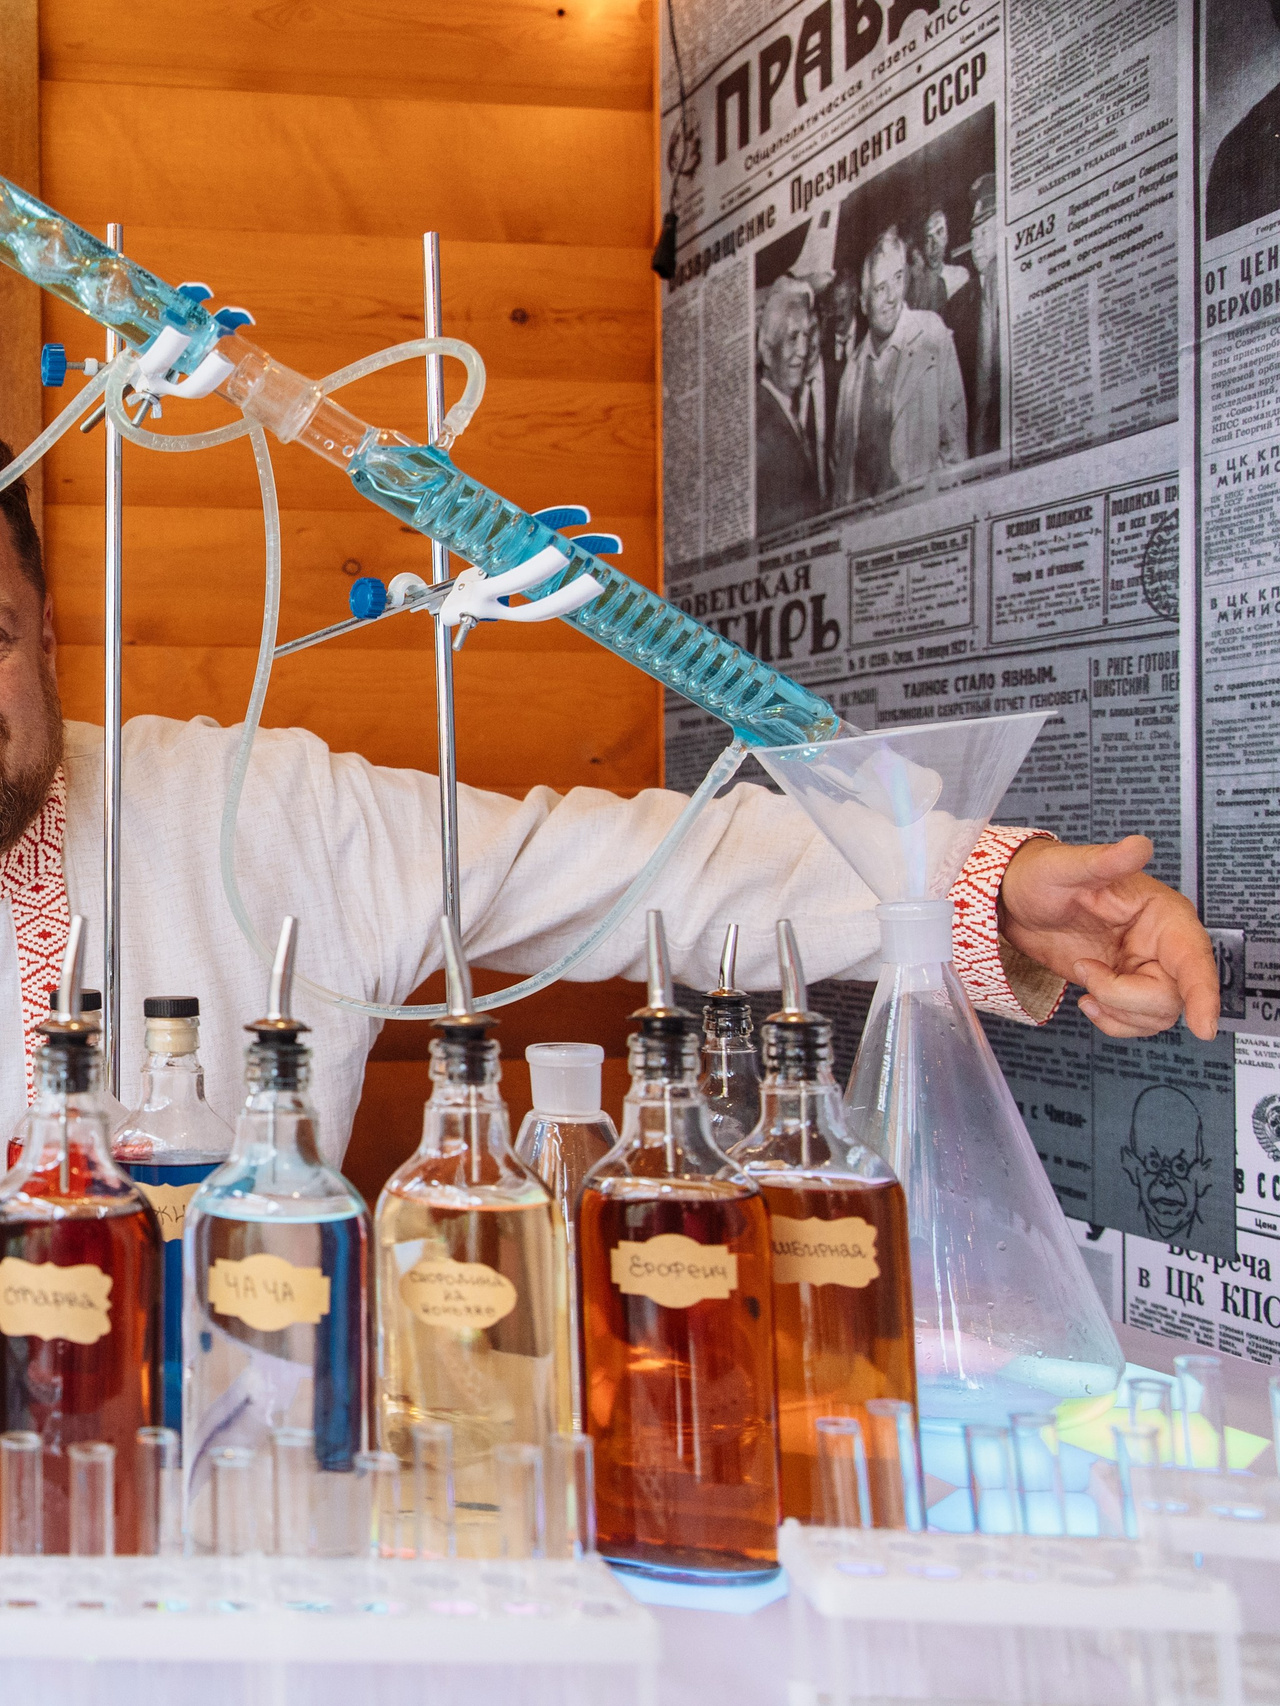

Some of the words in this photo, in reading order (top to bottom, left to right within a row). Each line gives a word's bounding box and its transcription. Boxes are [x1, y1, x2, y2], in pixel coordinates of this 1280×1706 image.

[743, 79, 863, 171] Общеполитическая
[871, 39, 917, 77] газета
[924, 0, 971, 42] КПСС
[669, 204, 776, 293] озвращение
[791, 116, 907, 215] Президента
[923, 51, 987, 126] СССР
[1037, 166, 1082, 196] КОЛЛЕКТИВ
[1083, 141, 1127, 173] РЕДАКЦИИ
[1068, 188, 1110, 216] Президента
[1014, 213, 1056, 251] УКАЗ
[1020, 260, 1032, 272] Об
[1037, 245, 1067, 264] отмене
[1073, 191, 1174, 247] антиконституционных
[1047, 260, 1071, 276] актов
[1077, 223, 1144, 262] организаторов
[1028, 261, 1104, 301] государственного
[1109, 231, 1164, 262] переворота
[1205, 265, 1227, 295] ОТ
[1235, 334, 1266, 349] Совета
[1211, 366, 1236, 380] после
[1212, 357, 1230, 369] ким
[1211, 369, 1255, 391] тируемой
[1225, 382, 1255, 397] новым
[1212, 386, 1278, 412] исследований,
[1212, 418, 1239, 434] КПСС
[1212, 431, 1232, 445] ский
[1235, 420, 1273, 439] Георгий
[1210, 463, 1217, 475] В
[1227, 454, 1248, 472] ЦК
[1111, 488, 1160, 516] ПОДПИСКА
[1210, 598, 1217, 610] В
[1227, 592, 1248, 607] ЦК
[707, 593, 840, 662] БИРЬ
[1093, 659, 1099, 677] В
[1107, 656, 1133, 676] РИГЕ
[903, 678, 949, 699] ТАЙНОЕ
[954, 672, 995, 694] СТАЛО
[1001, 665, 1057, 689] ЯВНЫМ.
[994, 694, 1025, 712] ОТЧЕТ
[1030, 688, 1089, 709] ГЕНСОВЕТА
[1255, 1218, 1277, 1231] Цена
[1138, 1267, 1150, 1289] в
[1166, 1265, 1204, 1306] ЦК
